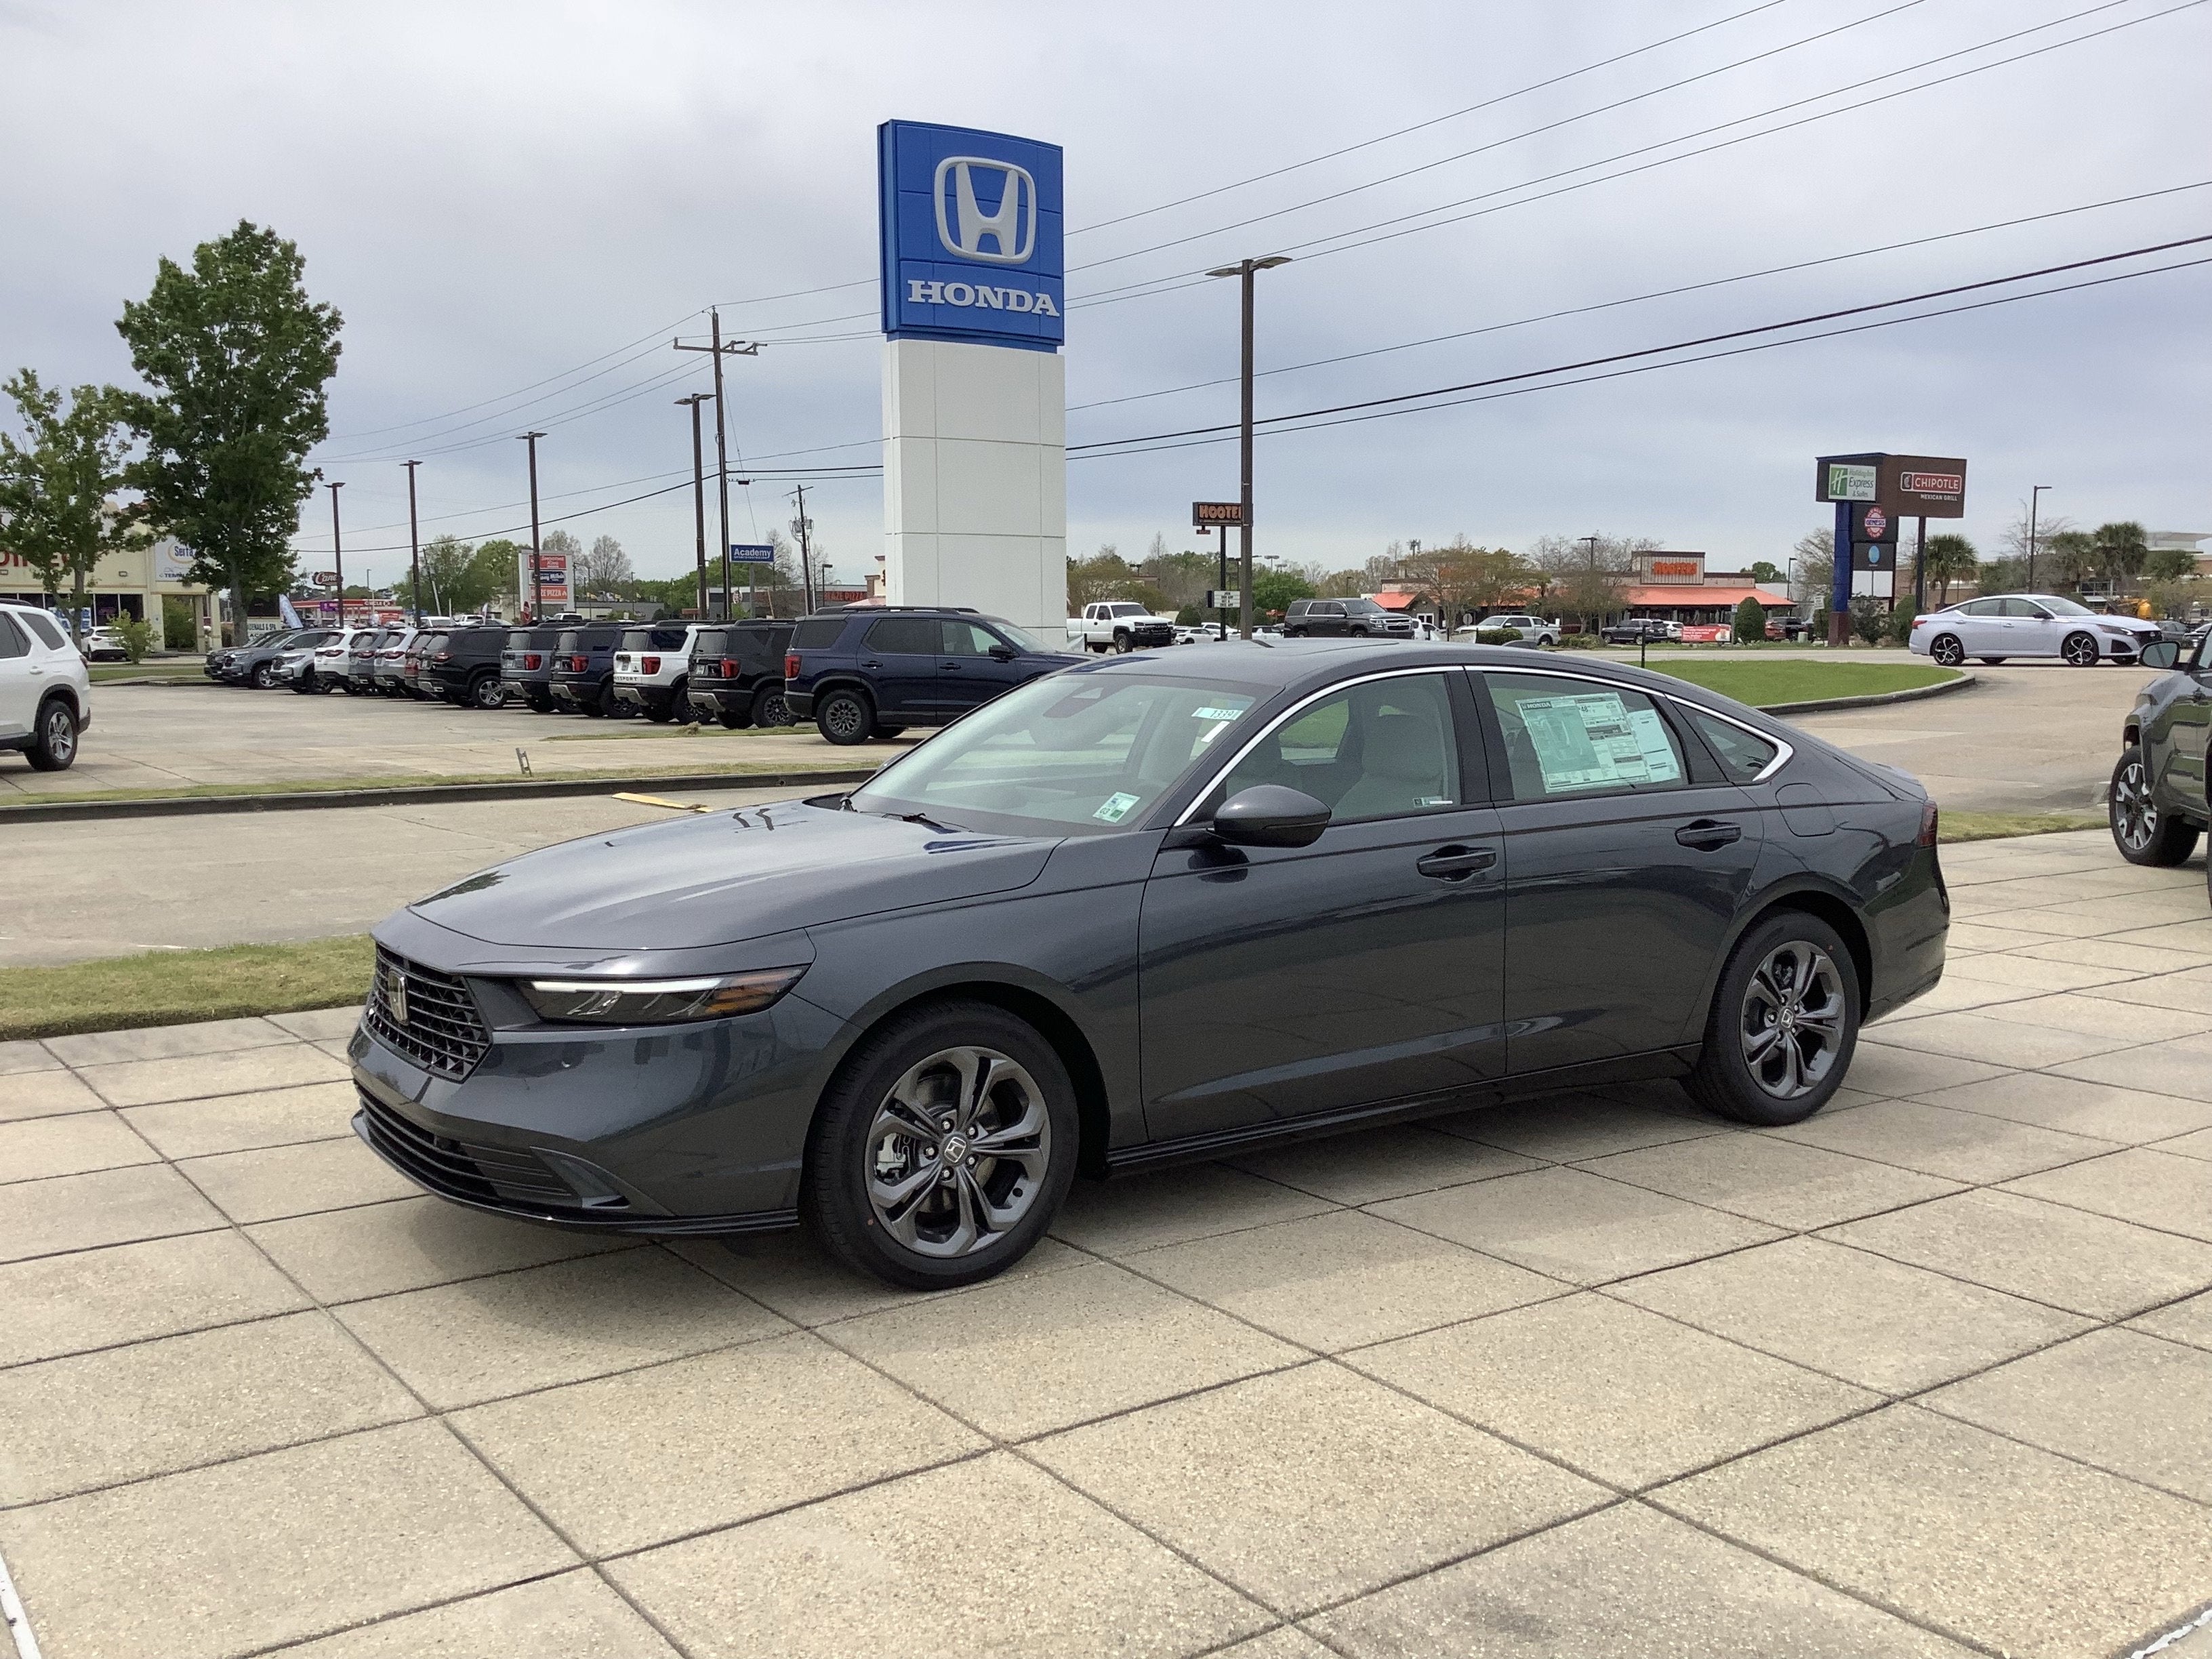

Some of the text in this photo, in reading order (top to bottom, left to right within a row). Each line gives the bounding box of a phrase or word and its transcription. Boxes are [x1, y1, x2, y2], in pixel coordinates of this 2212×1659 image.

[907, 279, 1061, 317] HONDA
[1848, 476, 1874, 490] Express
[1914, 477, 1959, 490] CHIPOTLE
[174, 546, 193, 557] Serta
[733, 548, 771, 558] Academy
[1526, 701, 1551, 710] HONDA
[1210, 710, 1235, 718] 1339
